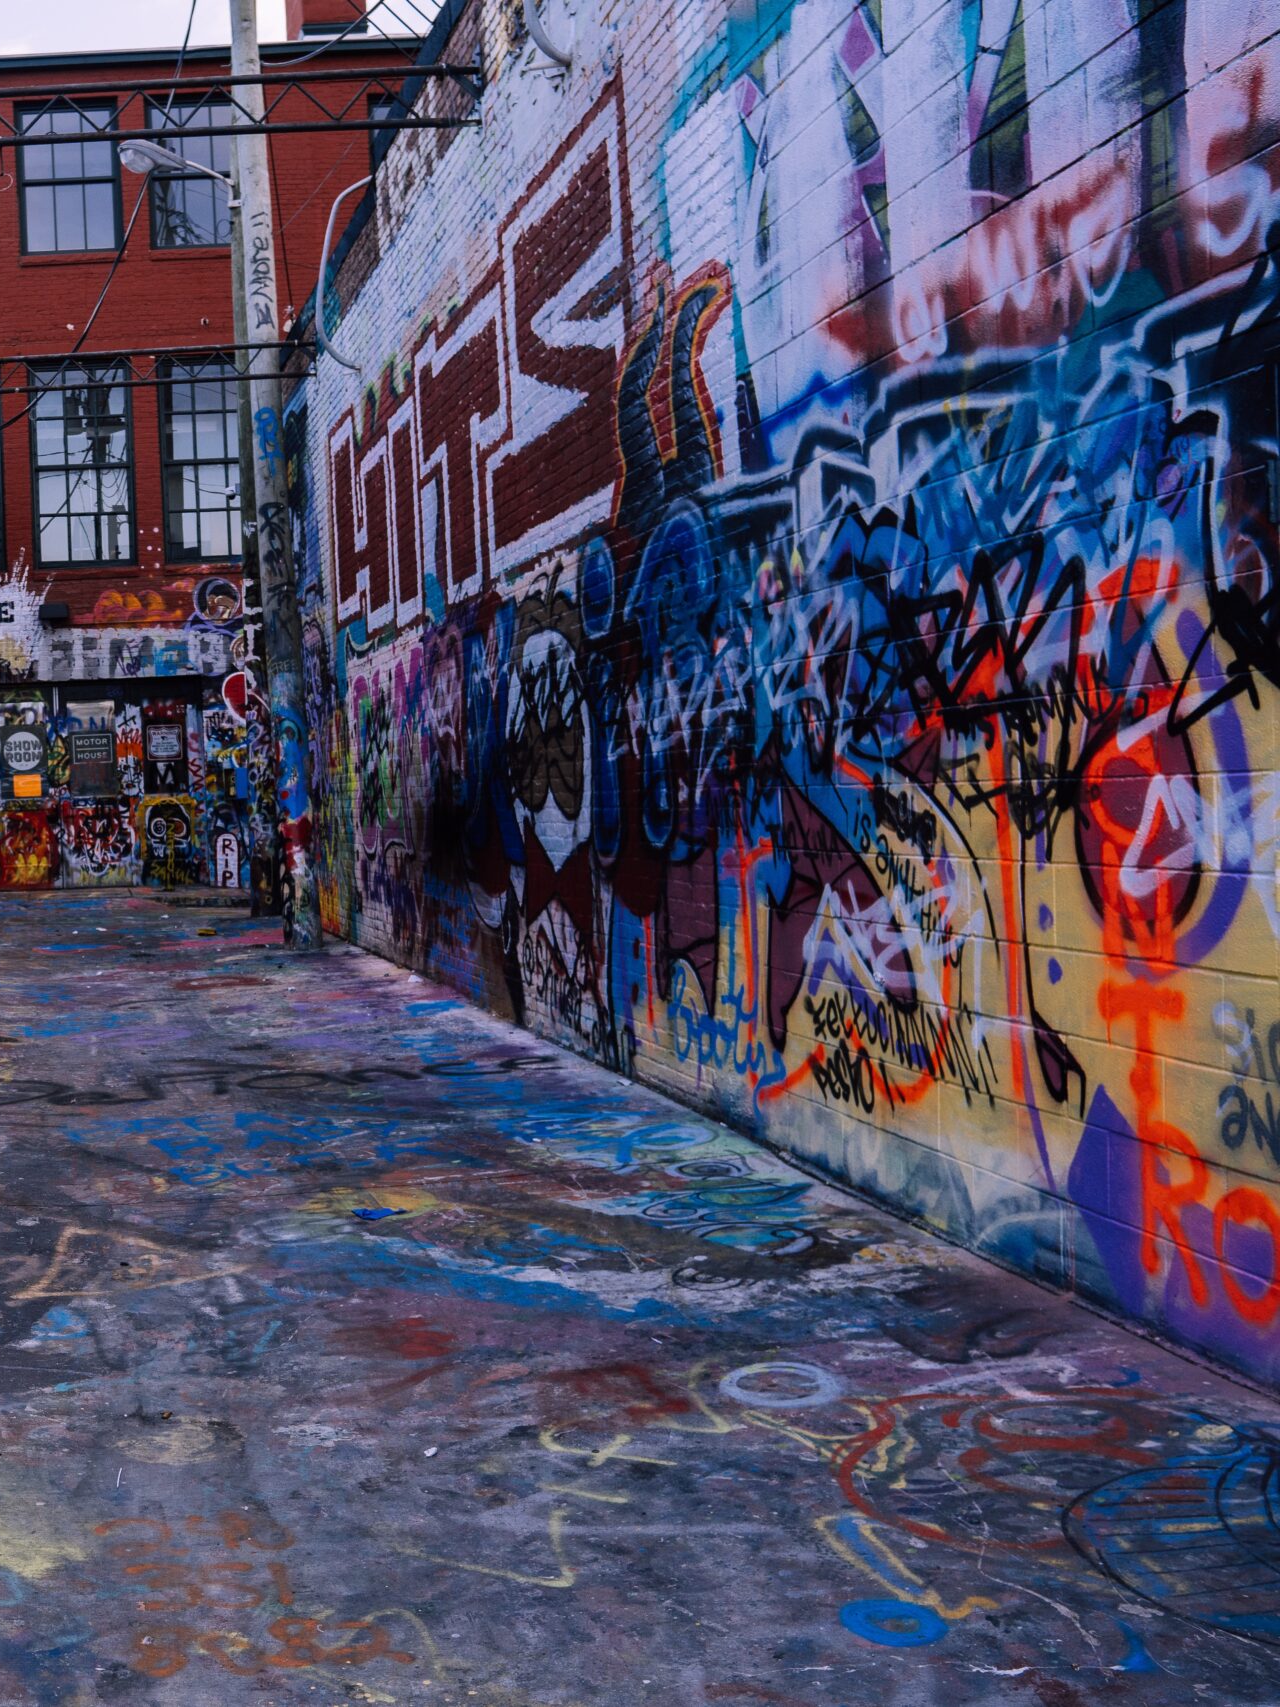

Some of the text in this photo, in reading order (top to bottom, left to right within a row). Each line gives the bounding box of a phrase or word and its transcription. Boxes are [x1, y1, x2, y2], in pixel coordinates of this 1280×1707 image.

[5, 740, 42, 752] SHOW
[75, 738, 108, 746] MOTOR
[5, 751, 42, 763] ROOM
[77, 751, 108, 760] HOUSE
